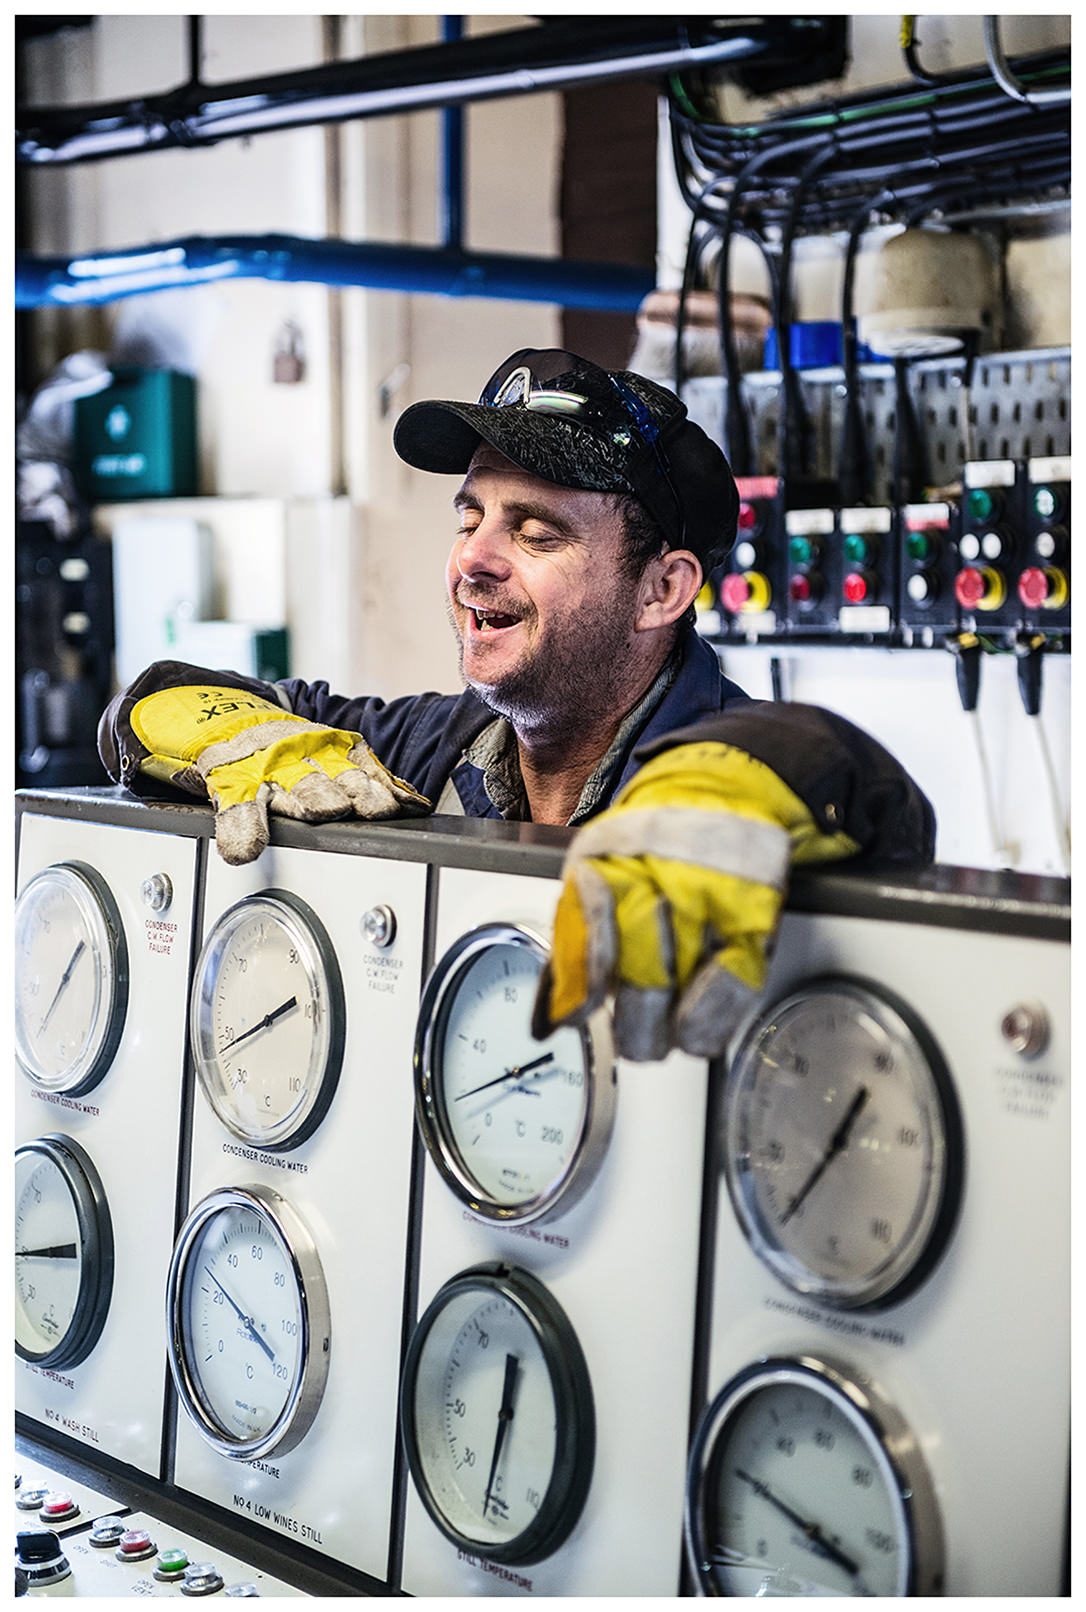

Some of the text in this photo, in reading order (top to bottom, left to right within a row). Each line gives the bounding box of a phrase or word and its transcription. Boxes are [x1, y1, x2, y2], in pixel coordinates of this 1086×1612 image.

[145, 919, 178, 932] CONDENSER
[159, 933, 174, 943] FLOW
[149, 942, 171, 955] FAILURE
[289, 949, 300, 964] 90
[238, 959, 248, 974] 70
[363, 954, 404, 969] CONDENSER
[368, 980, 396, 994] FAILURE
[225, 1027, 235, 1042] 50
[473, 1039, 487, 1054] 40
[237, 1068, 247, 1085] 30
[288, 1077, 300, 1093] 110
[31, 1090, 100, 1116] CONDENSER COOLING WATER
[222, 1143, 309, 1174] CONDENSER COOLING WATER
[543, 1232, 569, 1249] WATER
[227, 1254, 239, 1268] 40
[251, 1245, 263, 1261] 60
[274, 1271, 286, 1288] 80
[213, 1290, 224, 1305] 20
[281, 1319, 297, 1337] 100
[217, 1340, 224, 1353] 0
[272, 1361, 288, 1380] 120
[454, 1400, 465, 1418] 50
[61, 1414, 80, 1433] WASH
[82, 1425, 99, 1443] STILL
[463, 1447, 476, 1467] 30
[246, 1500, 252, 1512] 4
[254, 1503, 272, 1521] LOW
[273, 1511, 298, 1534] WINES
[301, 1524, 323, 1545] STILL
[480, 1558, 533, 1593] TEMPERATURE
